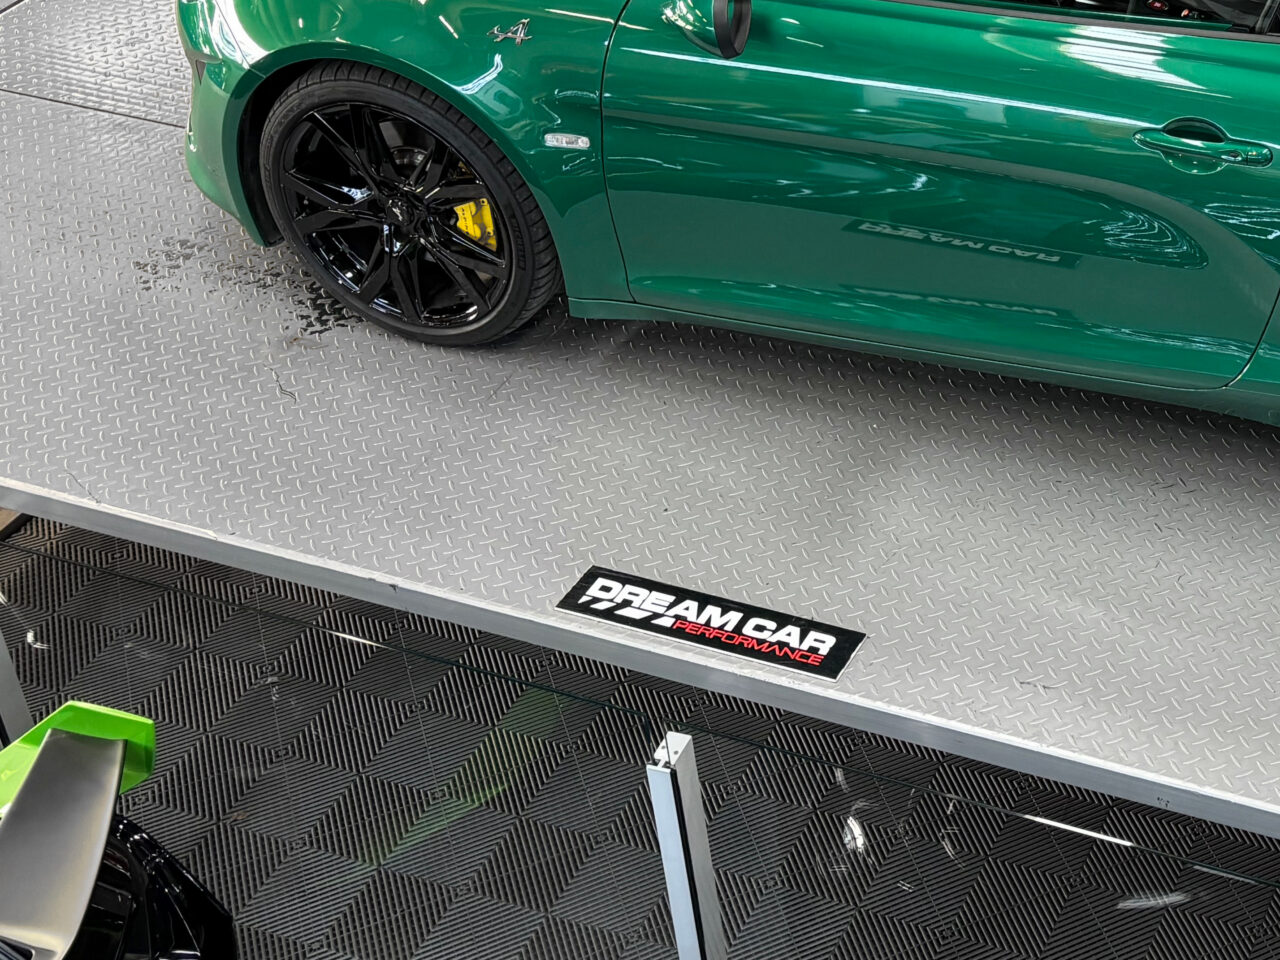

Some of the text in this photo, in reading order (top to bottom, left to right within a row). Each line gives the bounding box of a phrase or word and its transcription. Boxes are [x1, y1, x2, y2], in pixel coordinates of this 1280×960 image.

[585, 577, 836, 656] DREAM CAR
[673, 619, 825, 666] PERFORMANCE
